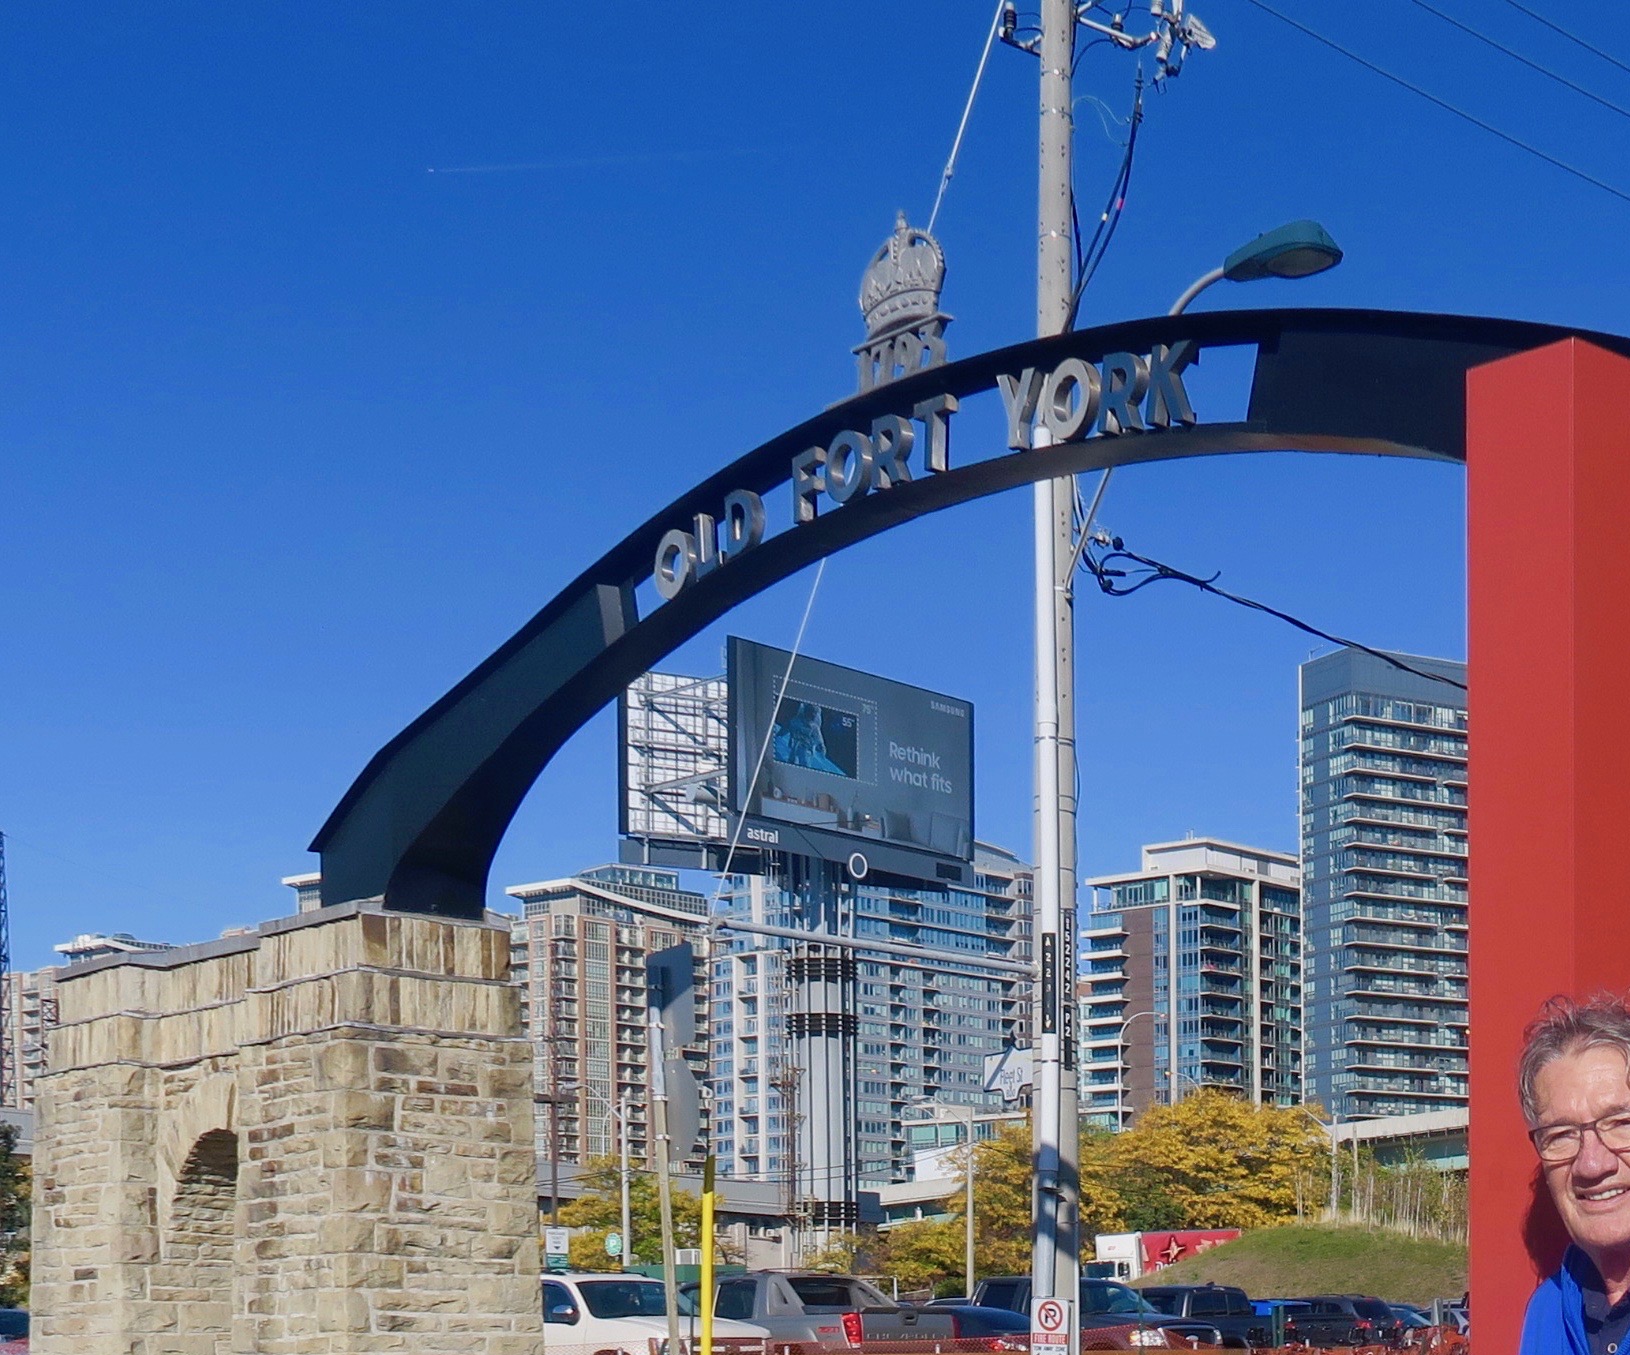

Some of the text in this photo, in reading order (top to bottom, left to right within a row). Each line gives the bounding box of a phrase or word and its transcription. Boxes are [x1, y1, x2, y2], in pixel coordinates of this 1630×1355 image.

[654, 339, 1198, 600] OLD FORT YORK
[930, 700, 965, 717] SAMSUNG
[889, 741, 941, 770] Rethink
[890, 766, 953, 794] what fits
[747, 827, 779, 844] astral
